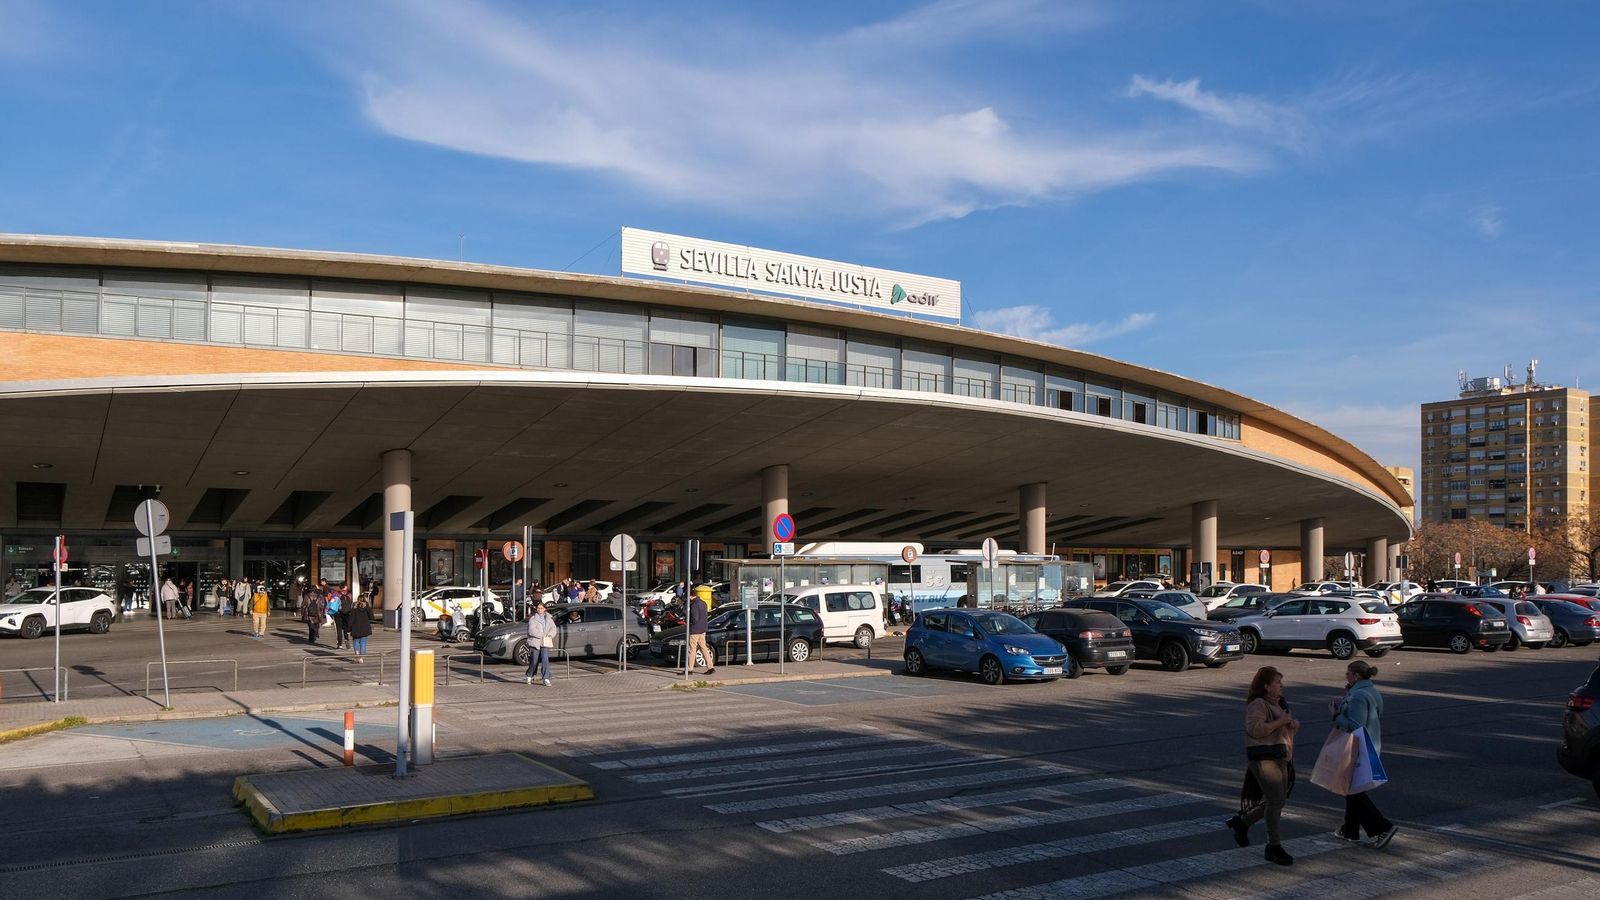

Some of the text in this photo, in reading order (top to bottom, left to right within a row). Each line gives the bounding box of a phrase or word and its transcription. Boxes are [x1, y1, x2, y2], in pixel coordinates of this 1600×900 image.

[680, 247, 882, 298] SEVILLA SANTA JUSTA
[907, 291, 940, 307] adif
[928, 594, 948, 603] BUS
